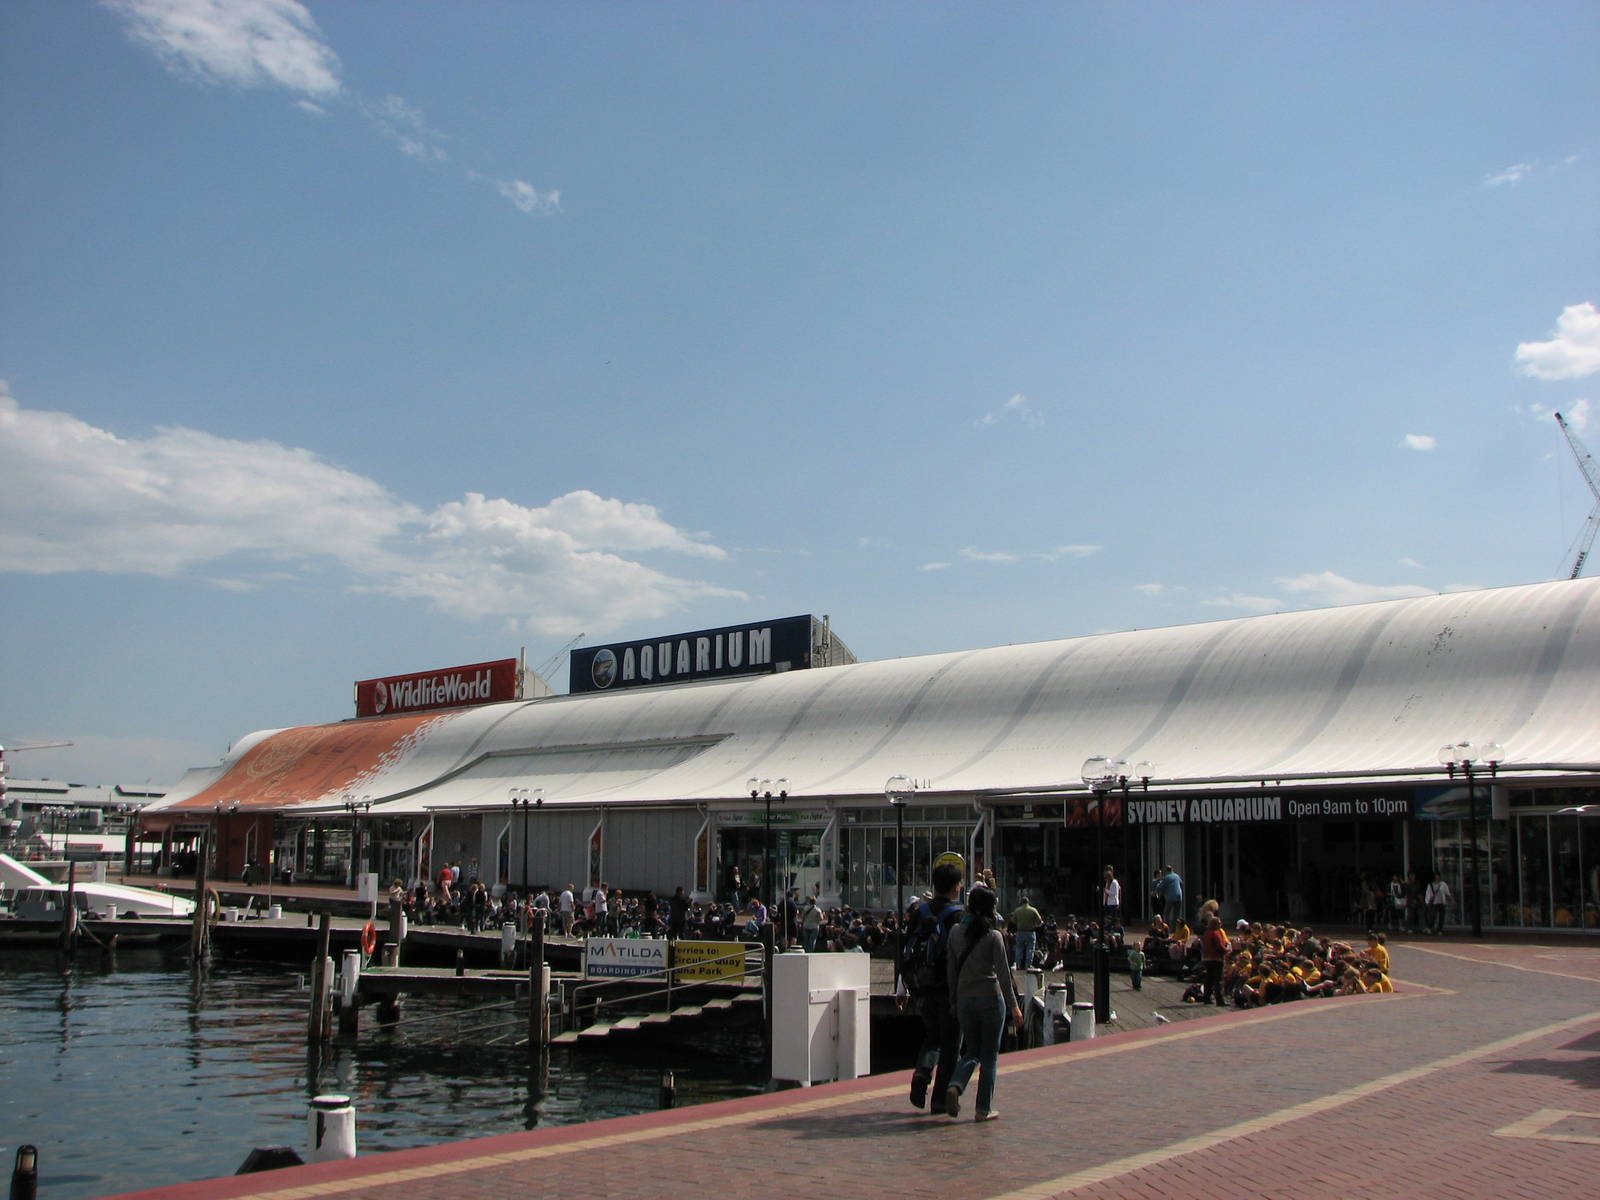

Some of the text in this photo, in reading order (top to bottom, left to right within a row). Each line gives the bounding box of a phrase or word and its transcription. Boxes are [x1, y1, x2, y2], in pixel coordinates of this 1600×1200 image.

[622, 627, 772, 681] AQUARIUM
[389, 669, 492, 709] WildlifeWorld
[1127, 796, 1282, 824] SYDNEY AQUARIUM
[1288, 798, 1408, 818] Open 9am to 10pm
[590, 942, 663, 959] MATILDA
[590, 967, 637, 976] BOARDING
[699, 967, 723, 976] Park
